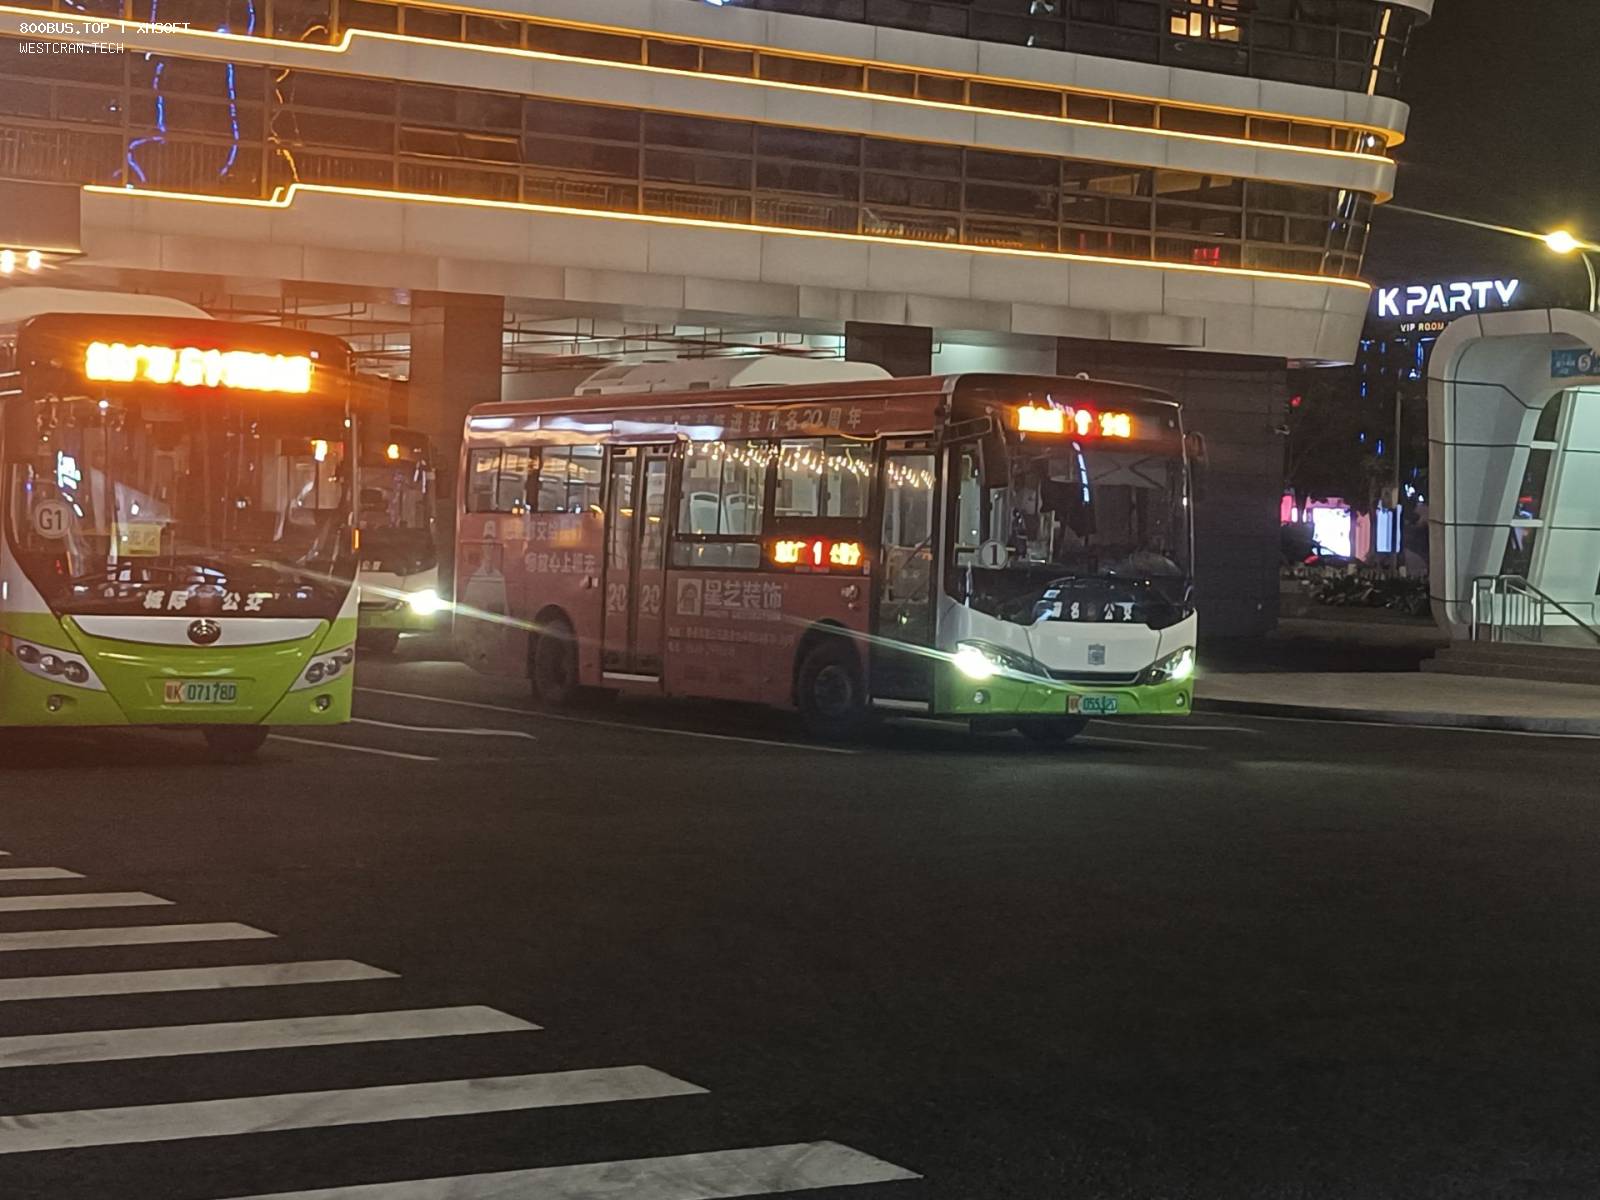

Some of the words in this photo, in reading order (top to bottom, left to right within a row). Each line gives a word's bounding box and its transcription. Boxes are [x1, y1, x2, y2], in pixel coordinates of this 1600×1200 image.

[1378, 287, 1400, 317] K
[1406, 279, 1519, 316] PARTY
[1400, 323, 1416, 333] VIP
[39, 507, 62, 531] G1
